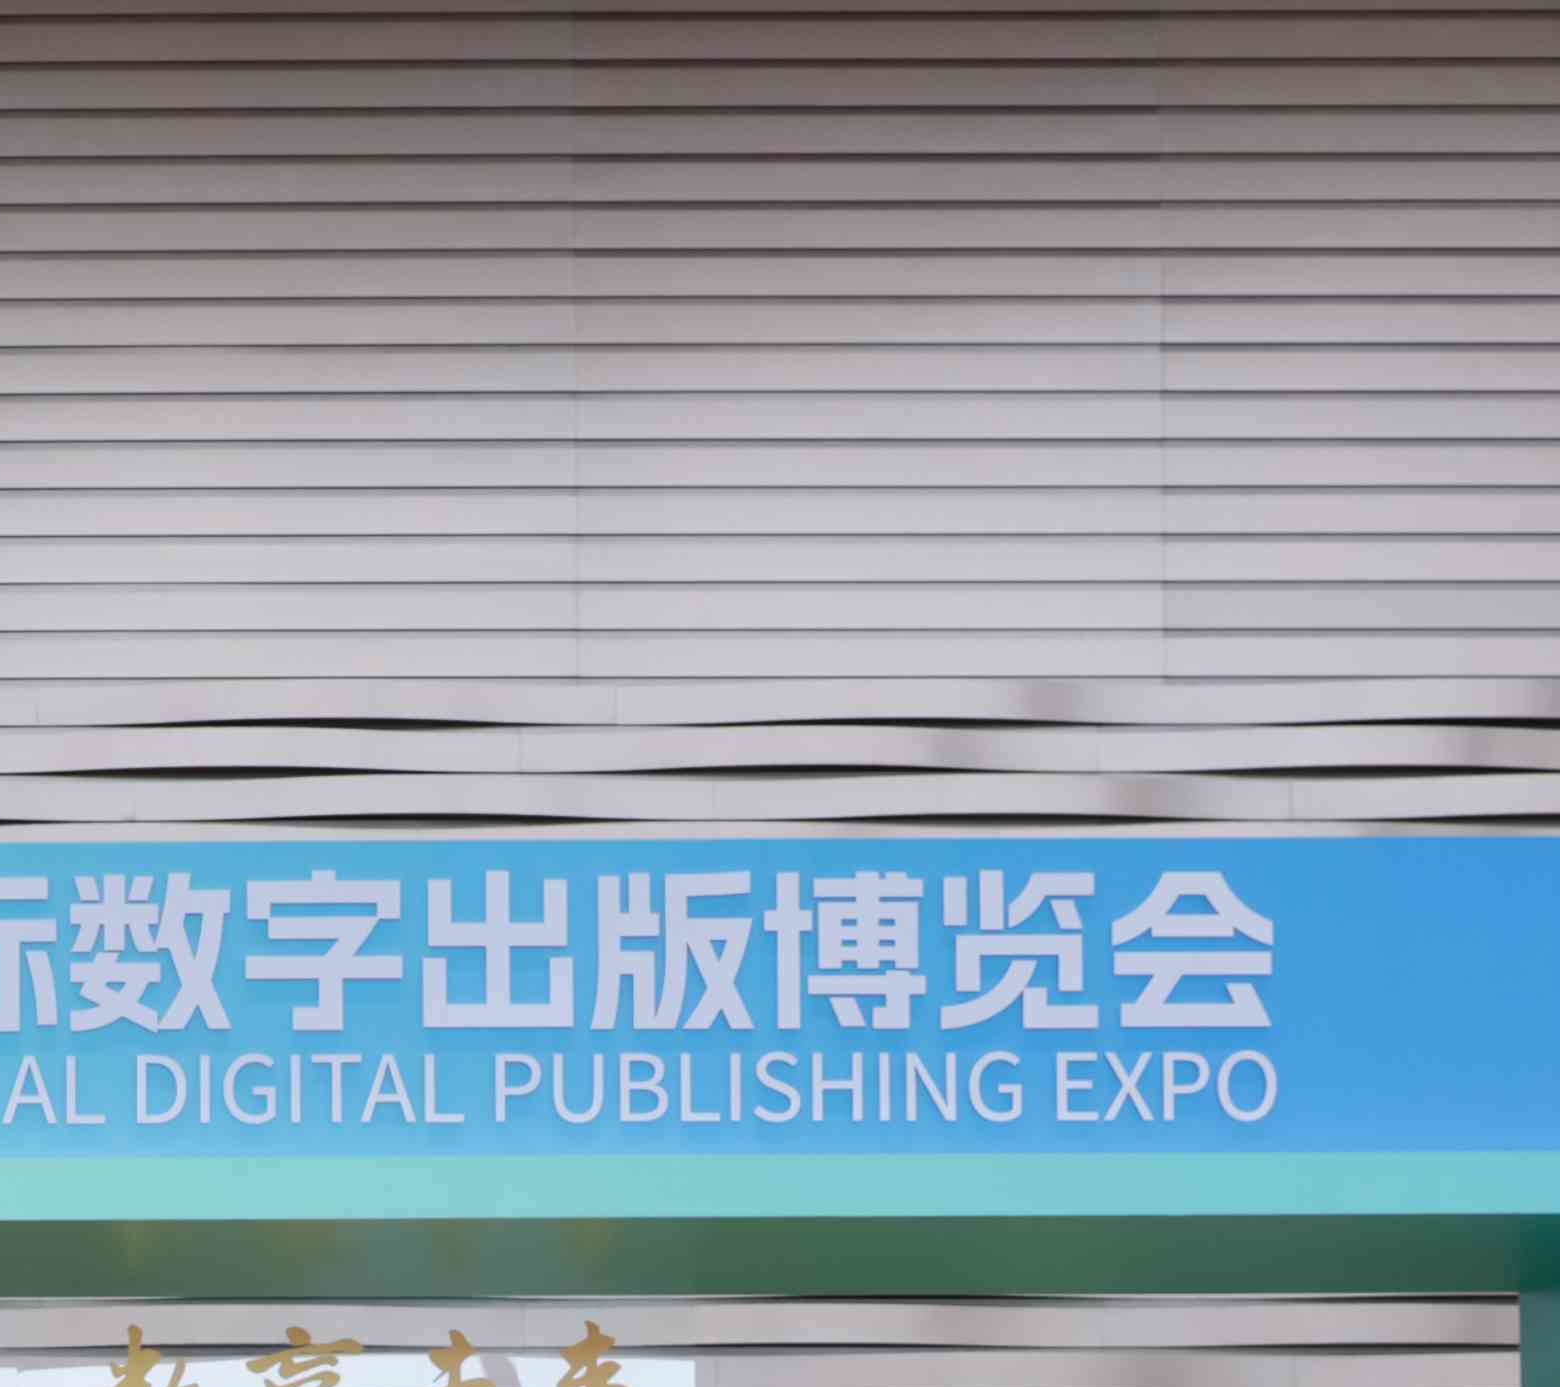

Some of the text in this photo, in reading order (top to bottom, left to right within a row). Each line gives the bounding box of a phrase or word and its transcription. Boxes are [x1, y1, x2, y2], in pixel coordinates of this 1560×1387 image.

[136, 1052, 464, 1126] DIGITAL
[496, 1048, 1026, 1125] PUBLISHING
[1057, 1048, 1279, 1124] EXPO
